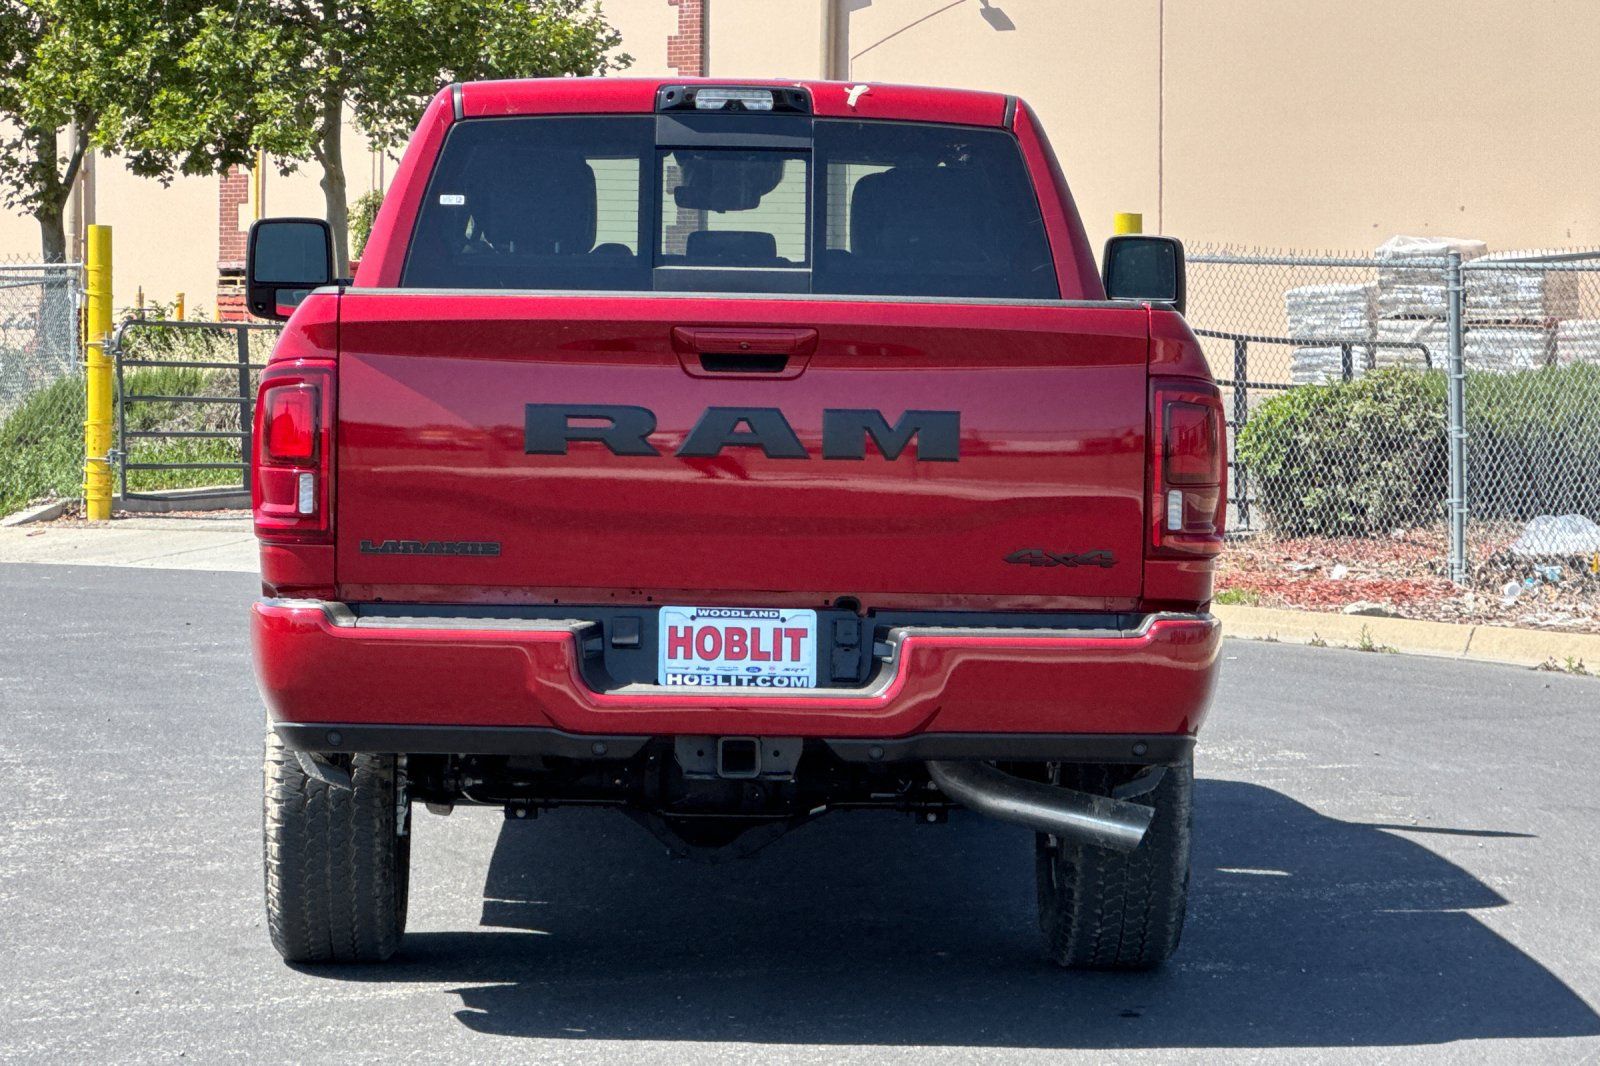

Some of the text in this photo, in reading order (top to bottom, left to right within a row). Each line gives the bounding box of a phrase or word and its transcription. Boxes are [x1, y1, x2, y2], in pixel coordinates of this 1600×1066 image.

[525, 403, 961, 462] RAM
[360, 540, 500, 556] LARAMIE
[1003, 548, 1118, 568] 4x4
[697, 609, 779, 618] WOODLAND
[667, 625, 808, 662] HOBLIT
[666, 674, 809, 687] HOBLIT.COM
